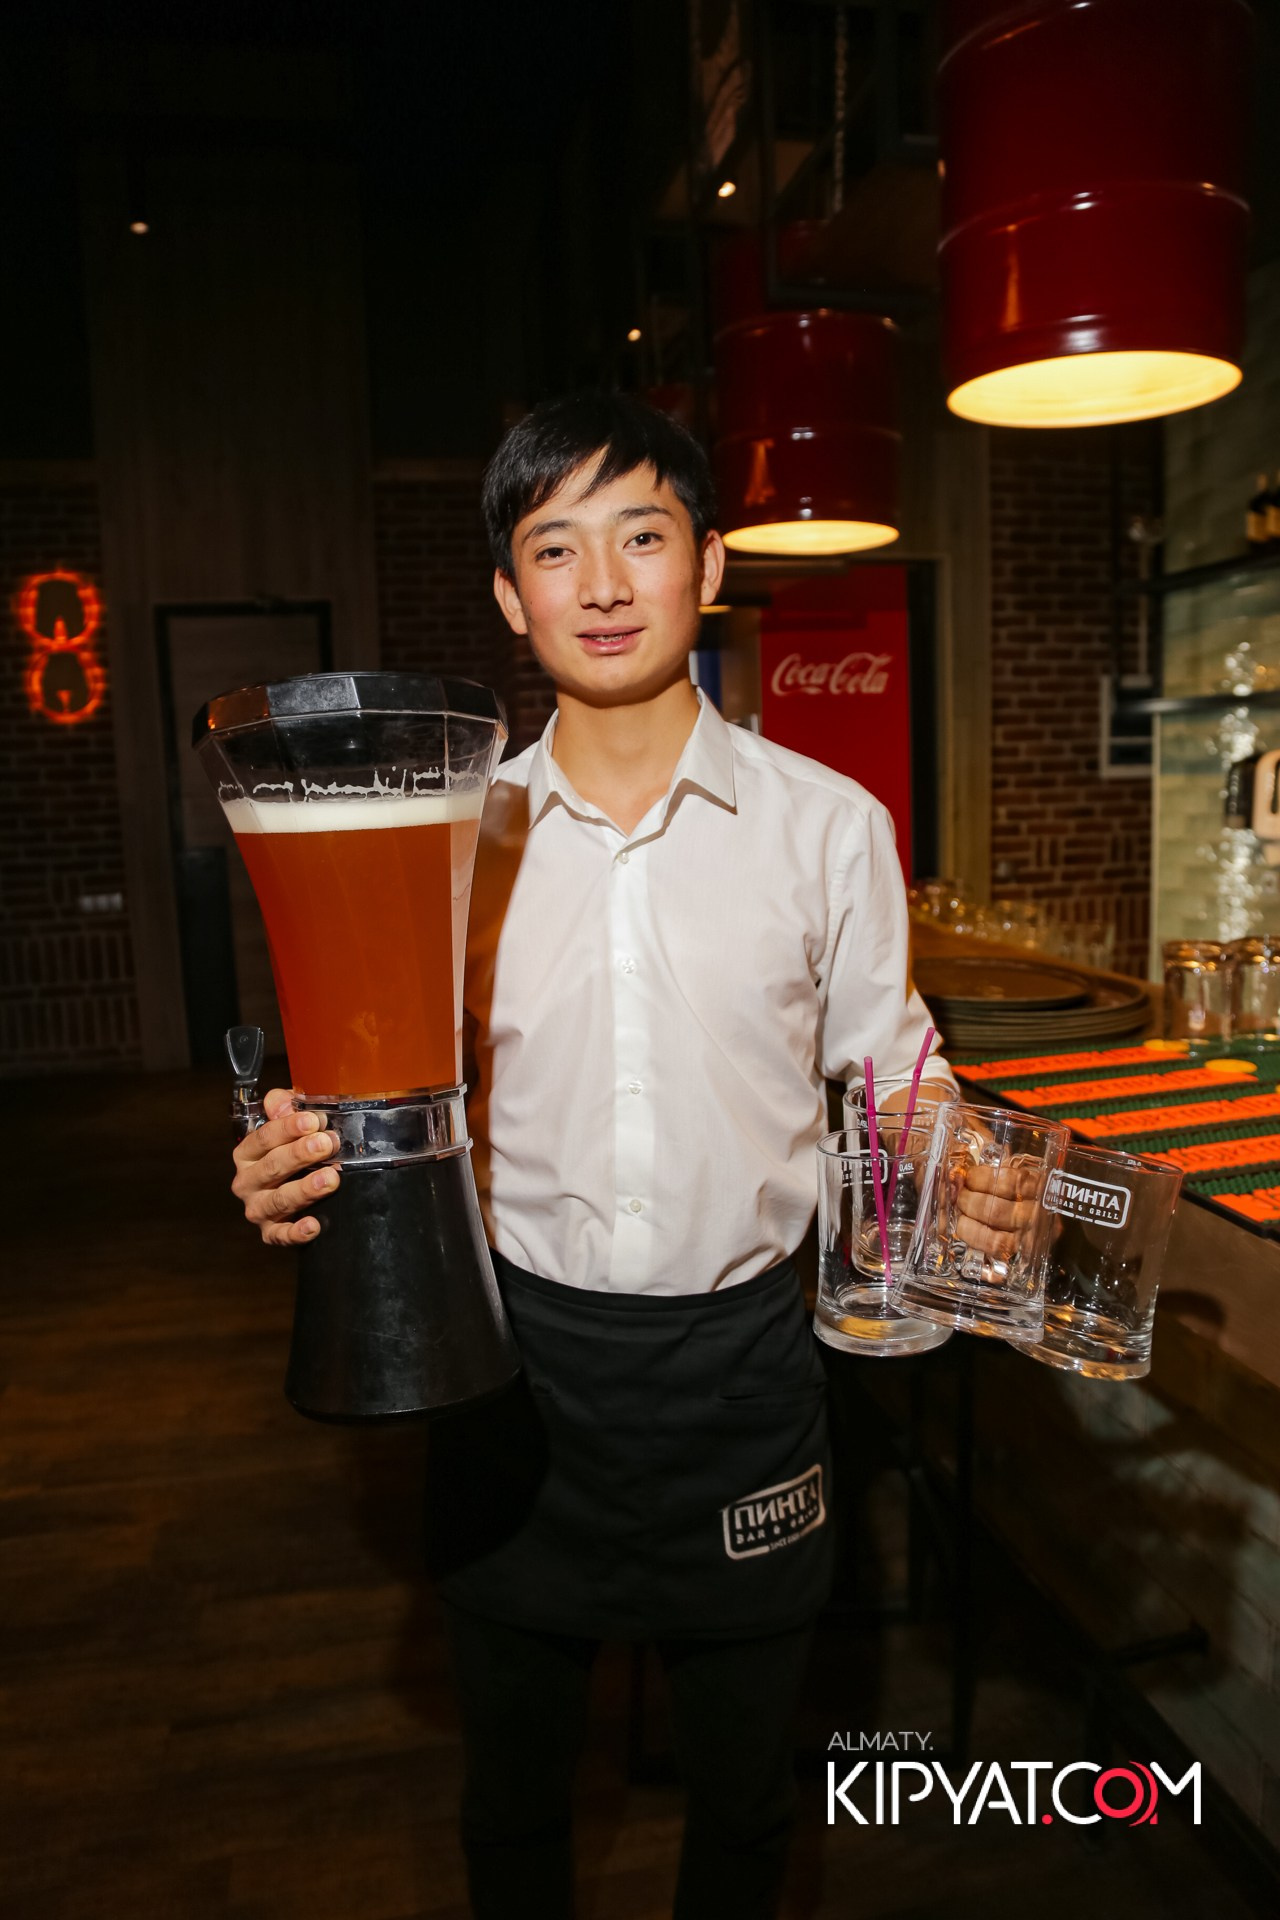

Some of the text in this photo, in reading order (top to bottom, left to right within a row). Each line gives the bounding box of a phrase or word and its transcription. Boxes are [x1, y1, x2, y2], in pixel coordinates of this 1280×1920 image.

[1061, 1181, 1120, 1211] ПИНТА
[1089, 1207, 1119, 1220] GRILL
[736, 1530, 766, 1544] BAR
